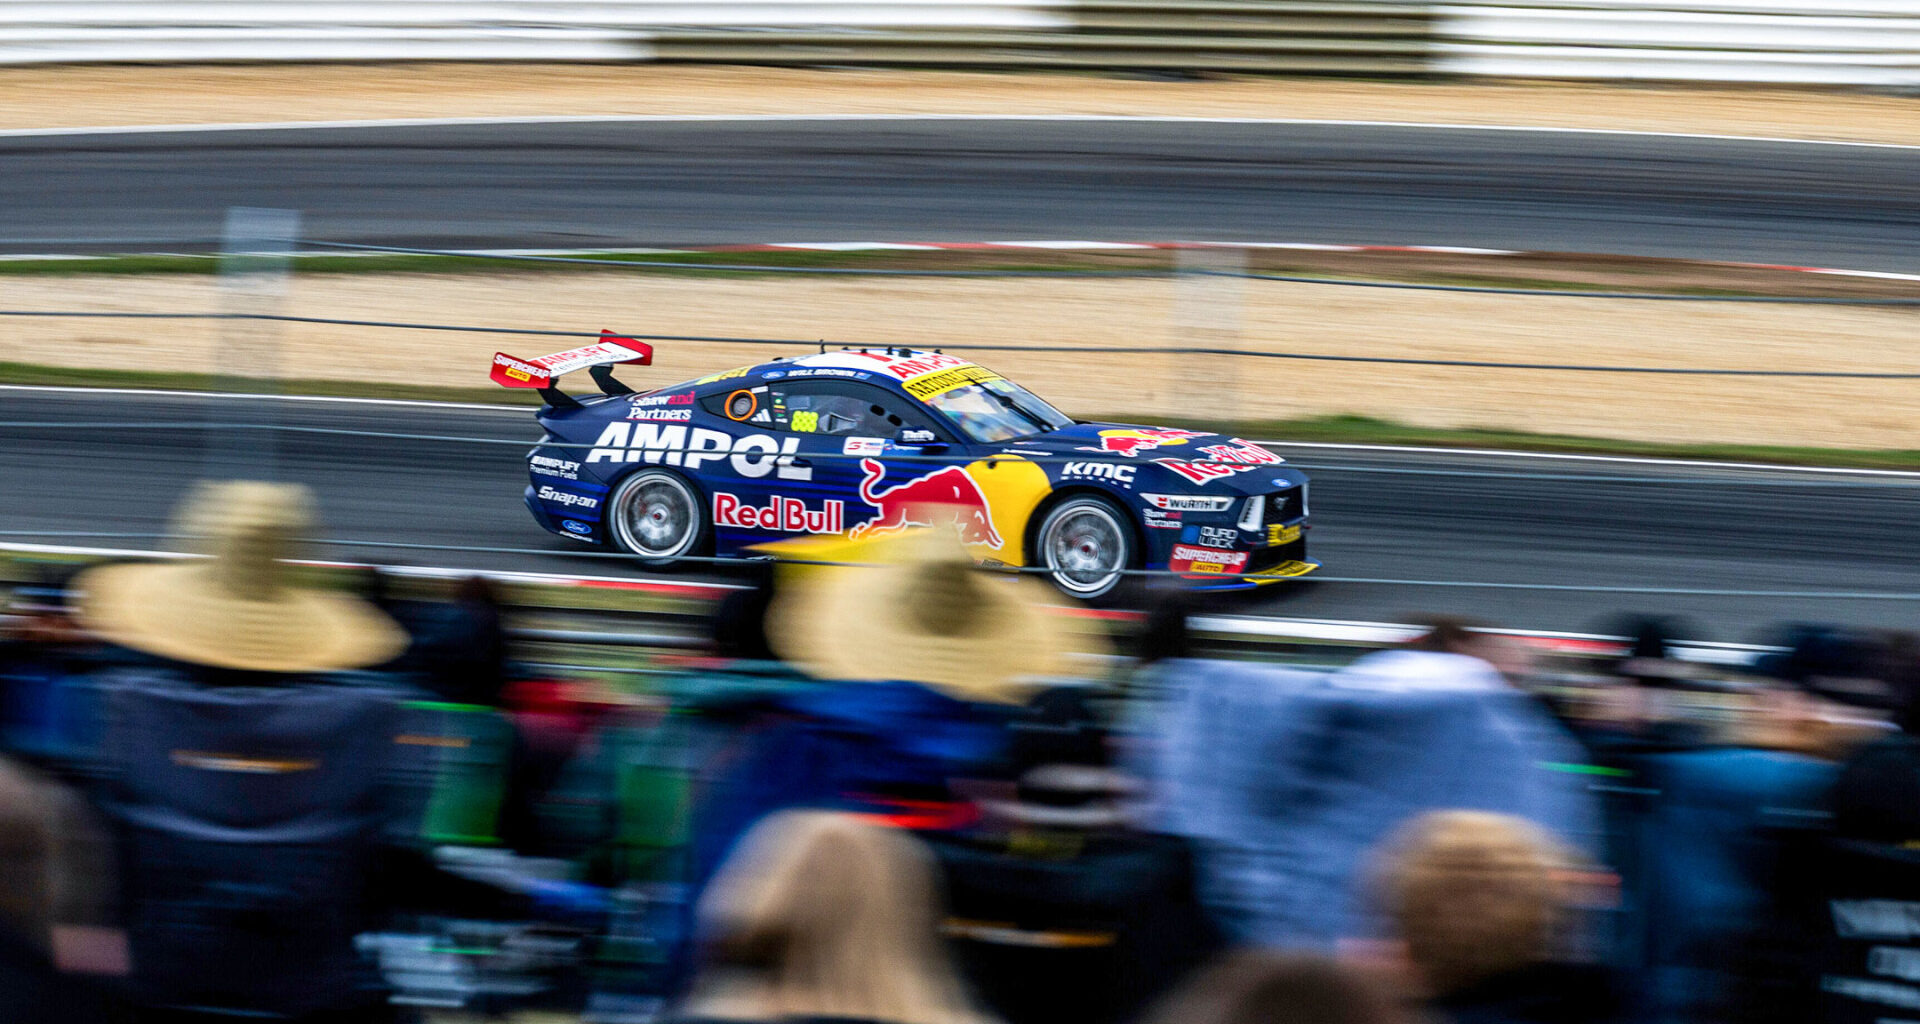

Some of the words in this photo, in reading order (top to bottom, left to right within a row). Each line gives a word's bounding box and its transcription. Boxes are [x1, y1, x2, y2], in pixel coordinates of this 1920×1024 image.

[494, 353, 552, 379] SUPERCHEAP
[508, 369, 529, 380] AUTO
[627, 407, 692, 421] Partners
[585, 421, 813, 481] AMPOL
[537, 456, 581, 471] AMPLIFY
[530, 464, 558, 476] Premium
[560, 469, 578, 480] Fuels
[538, 485, 598, 508] Snap-on
[713, 492, 781, 530] Red
[783, 498, 844, 534] Bull
[1199, 536, 1235, 549] LOCK
[1173, 547, 1248, 566] SUPERCHEAP
[1195, 563, 1220, 572] AUTO
